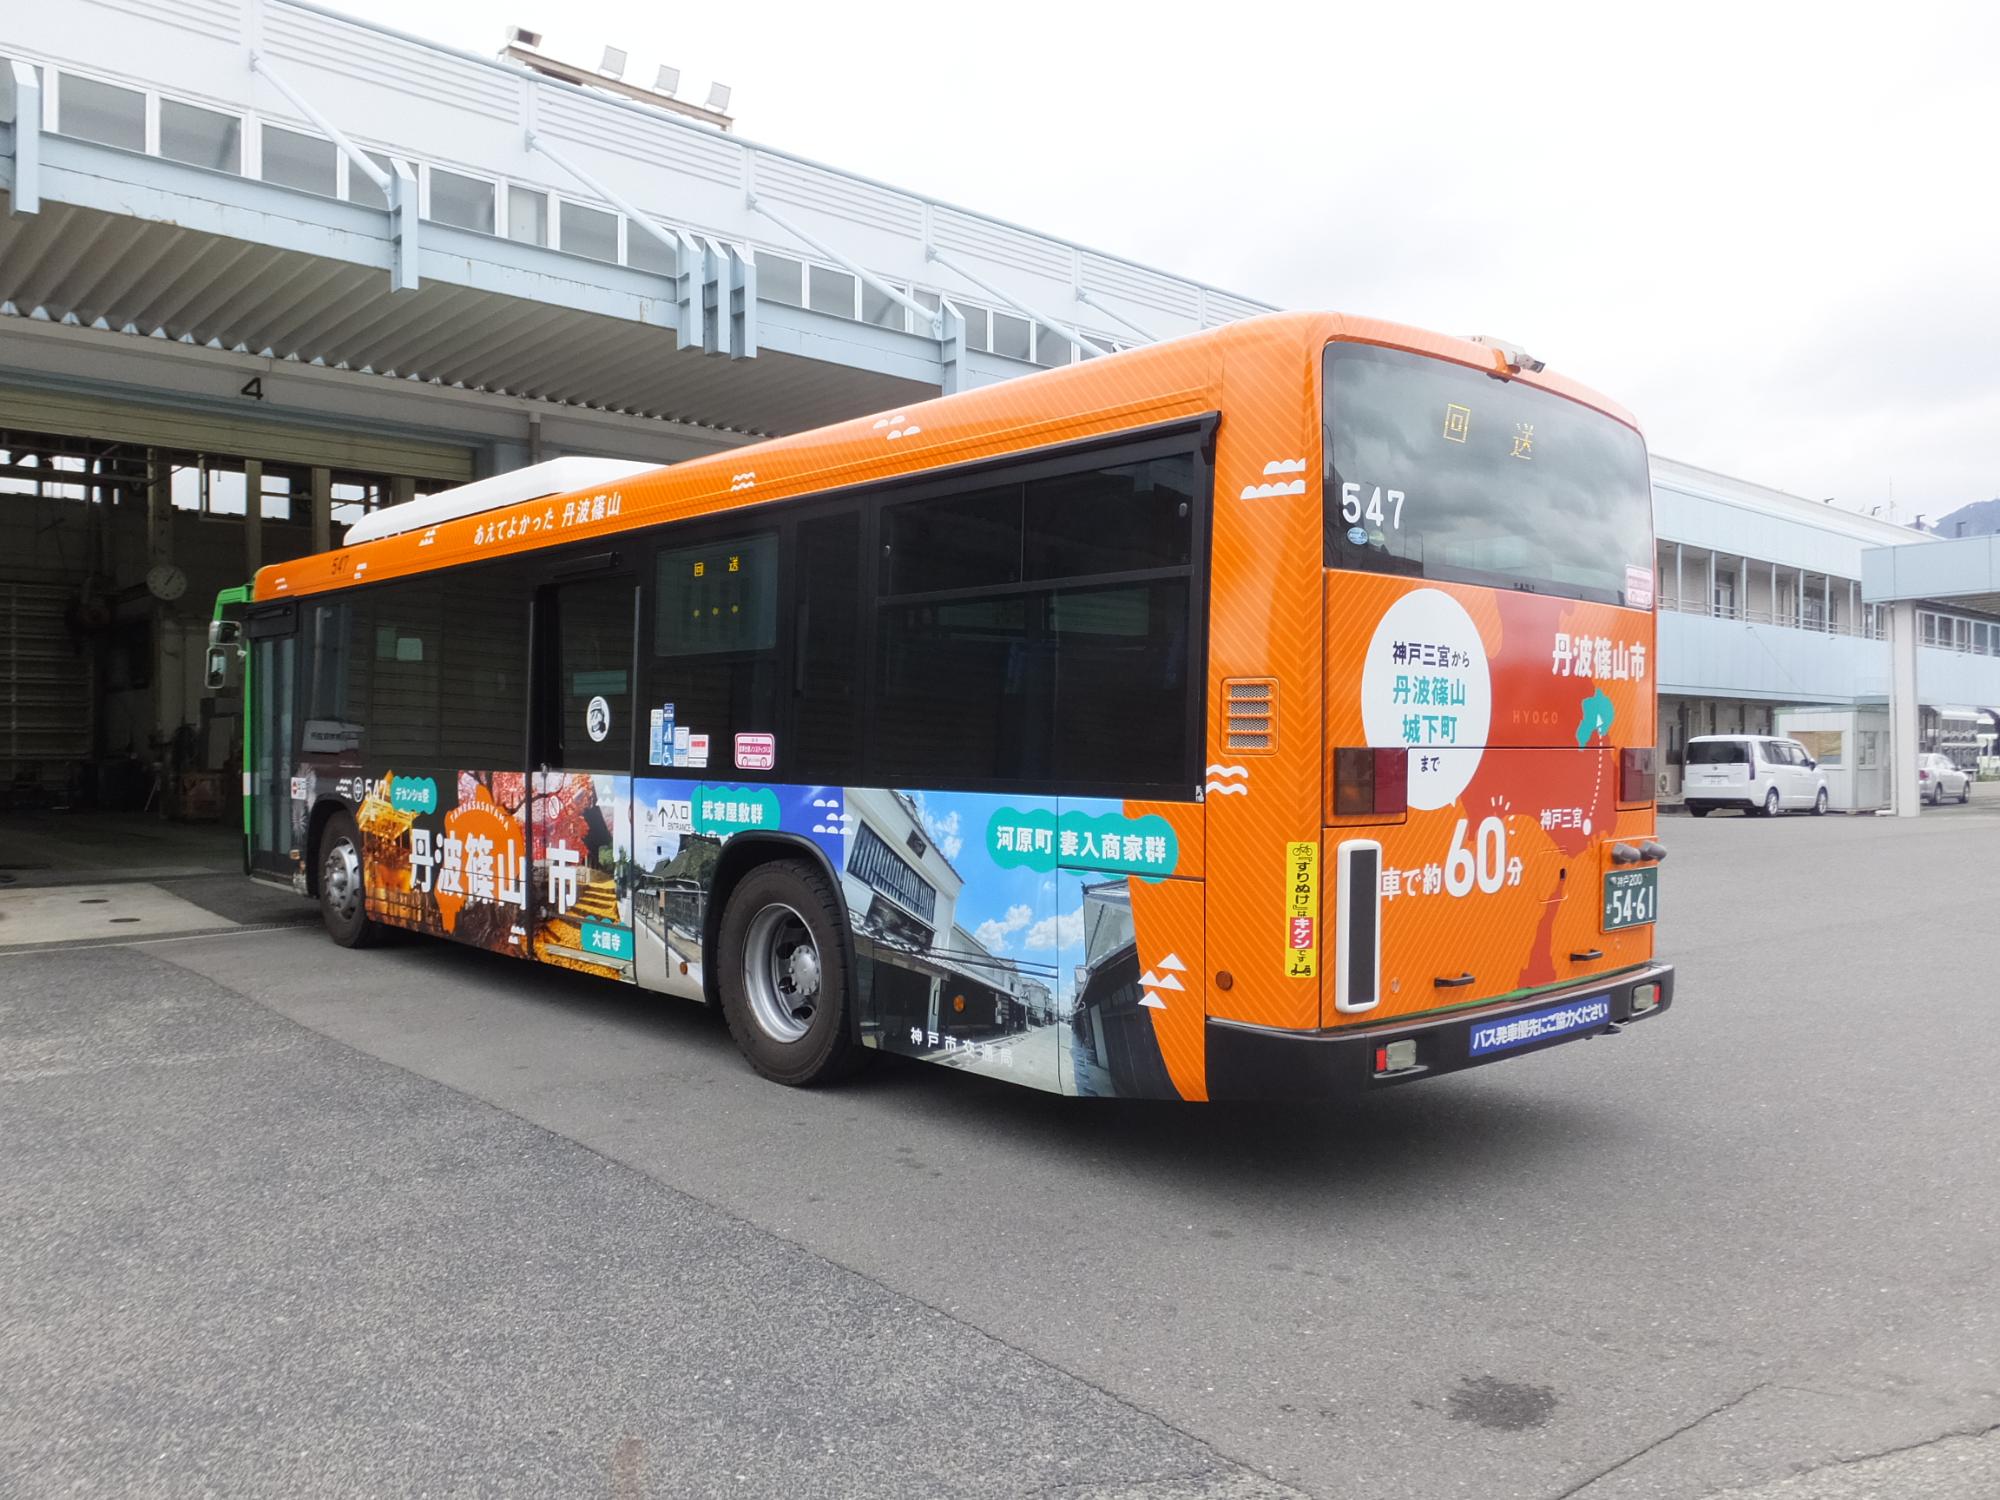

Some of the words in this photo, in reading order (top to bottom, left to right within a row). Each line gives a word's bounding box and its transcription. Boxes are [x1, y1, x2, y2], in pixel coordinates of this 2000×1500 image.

[241, 377, 263, 400] 4
[474, 507, 554, 545] あえてよかった
[561, 492, 622, 527] 丹波篠山
[1342, 482, 1405, 530] 547
[1392, 641, 1470, 668] 神戸三宮から
[1552, 632, 1646, 683] 丹波篠山市
[1392, 675, 1466, 707] 丹波篠山
[1402, 714, 1458, 744] 城下町
[1512, 709, 1559, 725] HYOGO
[1420, 755, 1441, 773] まで
[670, 803, 689, 820] 入口
[702, 800, 763, 824] 武家屋敷群
[1540, 807, 1583, 831] 神戸三宮
[1473, 1003, 1609, 1050] バス発車優先にご協力ください
[910, 1027, 1014, 1068] 神戸市交通局
